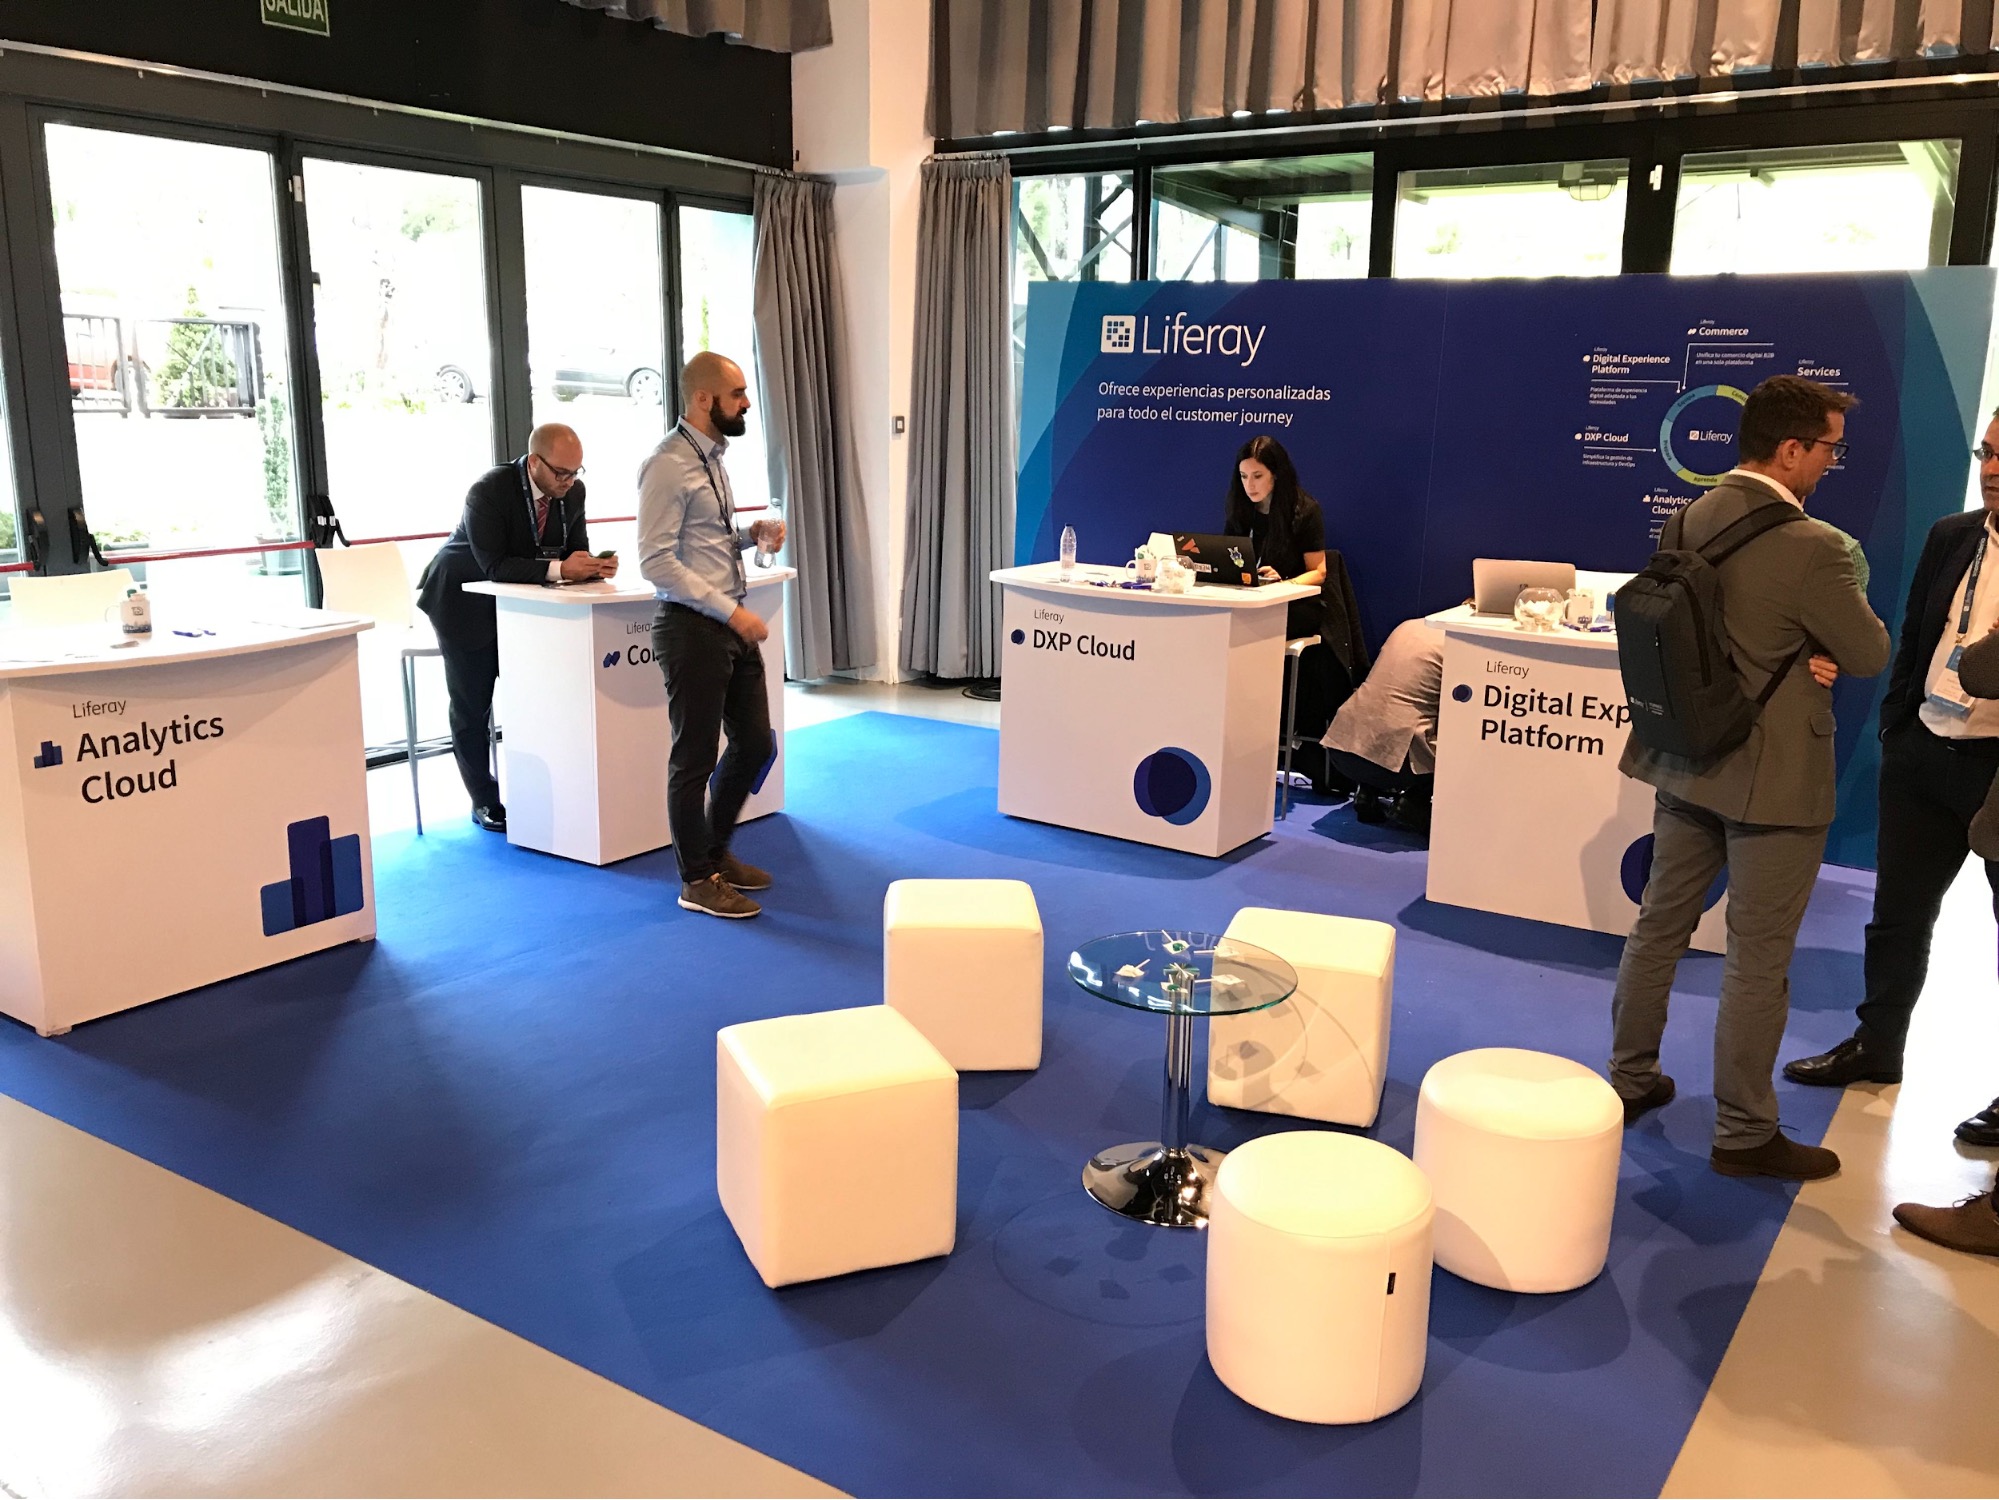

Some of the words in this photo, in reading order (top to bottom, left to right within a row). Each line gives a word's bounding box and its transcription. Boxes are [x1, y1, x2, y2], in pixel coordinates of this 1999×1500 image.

[1142, 311, 1267, 367] Liferay
[1699, 327, 1749, 336] Commerce
[1592, 354, 1621, 365] Digital
[1622, 354, 1670, 365] Experience
[1591, 365, 1630, 374] Platform
[1797, 366, 1841, 376] Services
[1098, 381, 1140, 397] Ofrece
[1142, 383, 1225, 400] experiencias
[1227, 385, 1331, 402] personalizadas
[1097, 407, 1125, 421] para
[1128, 406, 1158, 420] todo
[1160, 407, 1173, 420] el
[1175, 409, 1238, 423] customer
[1239, 409, 1293, 427] journey
[1584, 432, 1602, 441] DXP
[1603, 432, 1629, 442] Cloud
[1700, 430, 1733, 444] Liferay
[1652, 494, 1693, 506] Analytics
[1651, 505, 1678, 515] Cloud
[1034, 608, 1065, 624] Liferay
[626, 621, 652, 635] Lifera
[1033, 629, 1072, 652] DXP
[1076, 635, 1136, 661] Cloud
[1486, 660, 1530, 679] Liferay
[72, 700, 127, 719] Liferay
[1483, 684, 1573, 718] Digital
[76, 715, 224, 762] Analytics
[1480, 718, 1604, 756] Platform
[81, 759, 178, 804] Cloud
